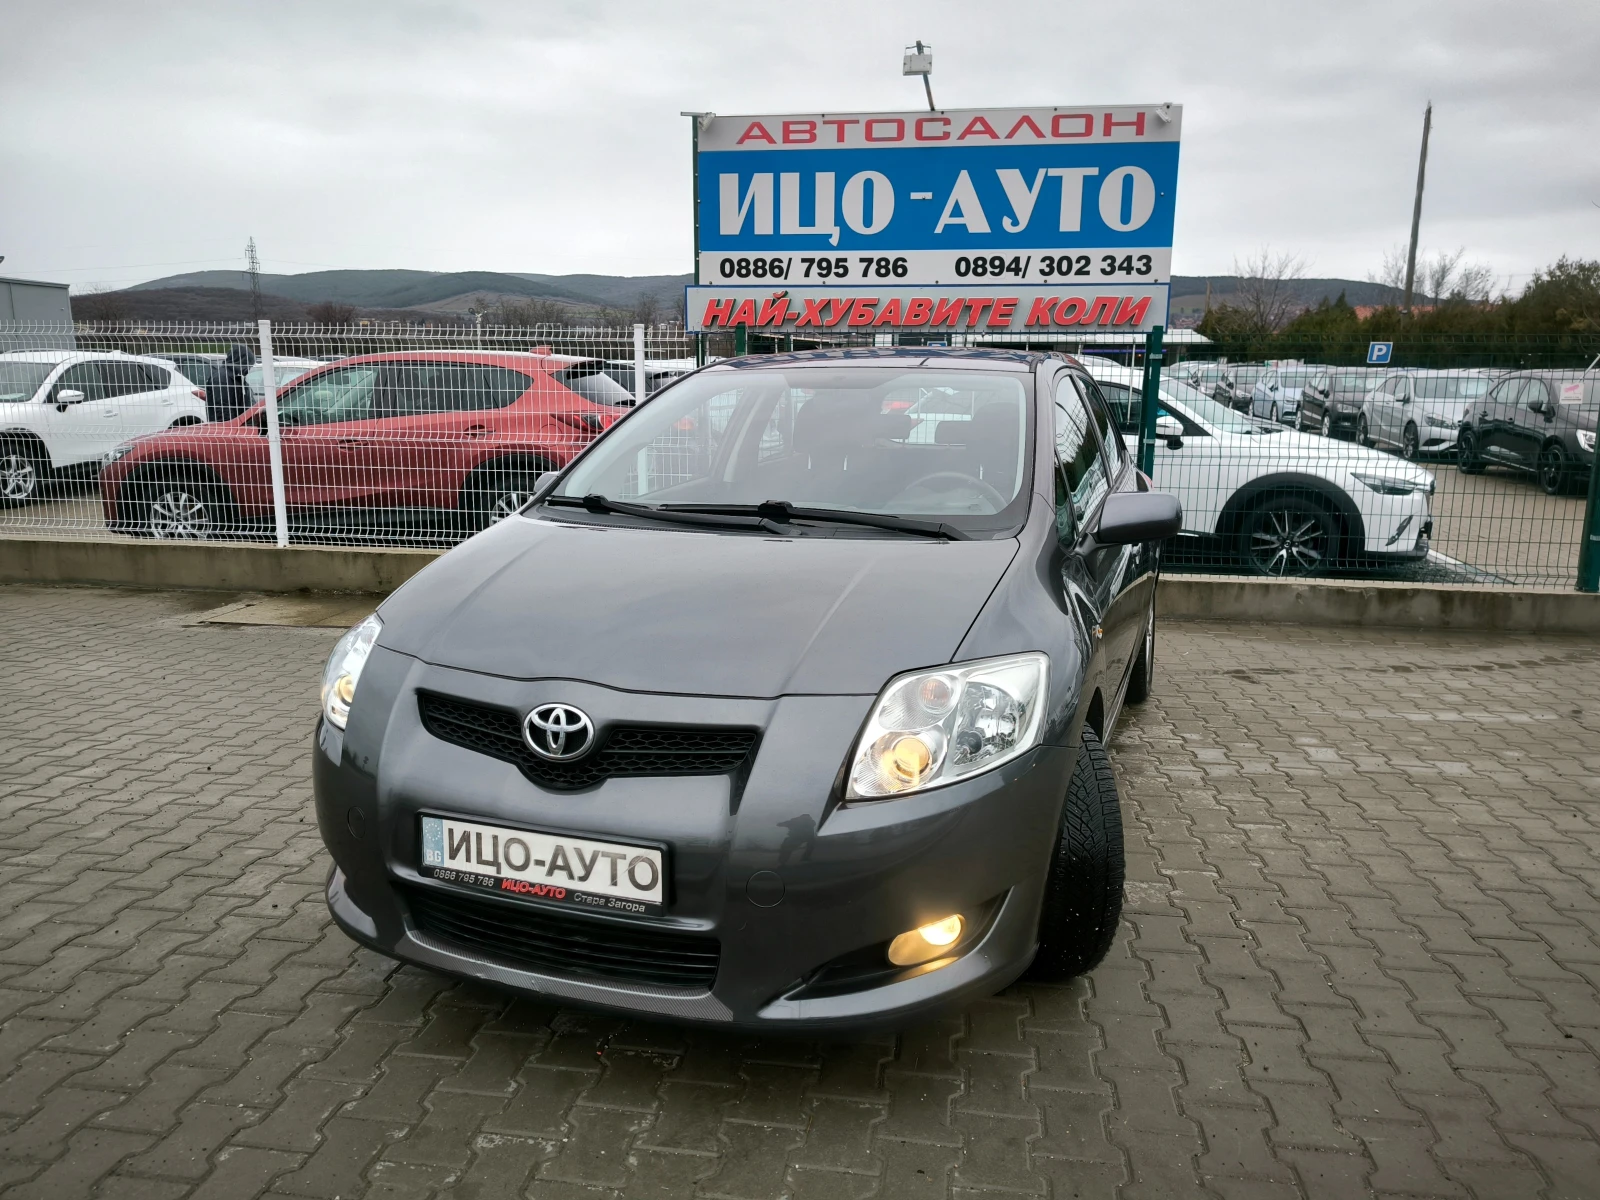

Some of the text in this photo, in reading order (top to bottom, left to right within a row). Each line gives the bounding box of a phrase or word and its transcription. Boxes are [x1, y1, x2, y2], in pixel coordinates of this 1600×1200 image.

[736, 111, 1146, 145] АВТОСАЛОН
[719, 254, 1153, 279] 0886/ 795 786 0894/ 302 343
[702, 290, 1153, 328] НАЙ-ХУБАВИТЕ КОЛИ
[1372, 344, 1387, 361] P
[426, 849, 442, 862] BG
[447, 827, 659, 892] ИЦО-АУТО
[458, 873, 476, 884] 795
[477, 876, 495, 887] 786
[501, 878, 566, 899] ИЦО-АУТО
[573, 892, 606, 906] Стара
[607, 897, 646, 912] Загора
